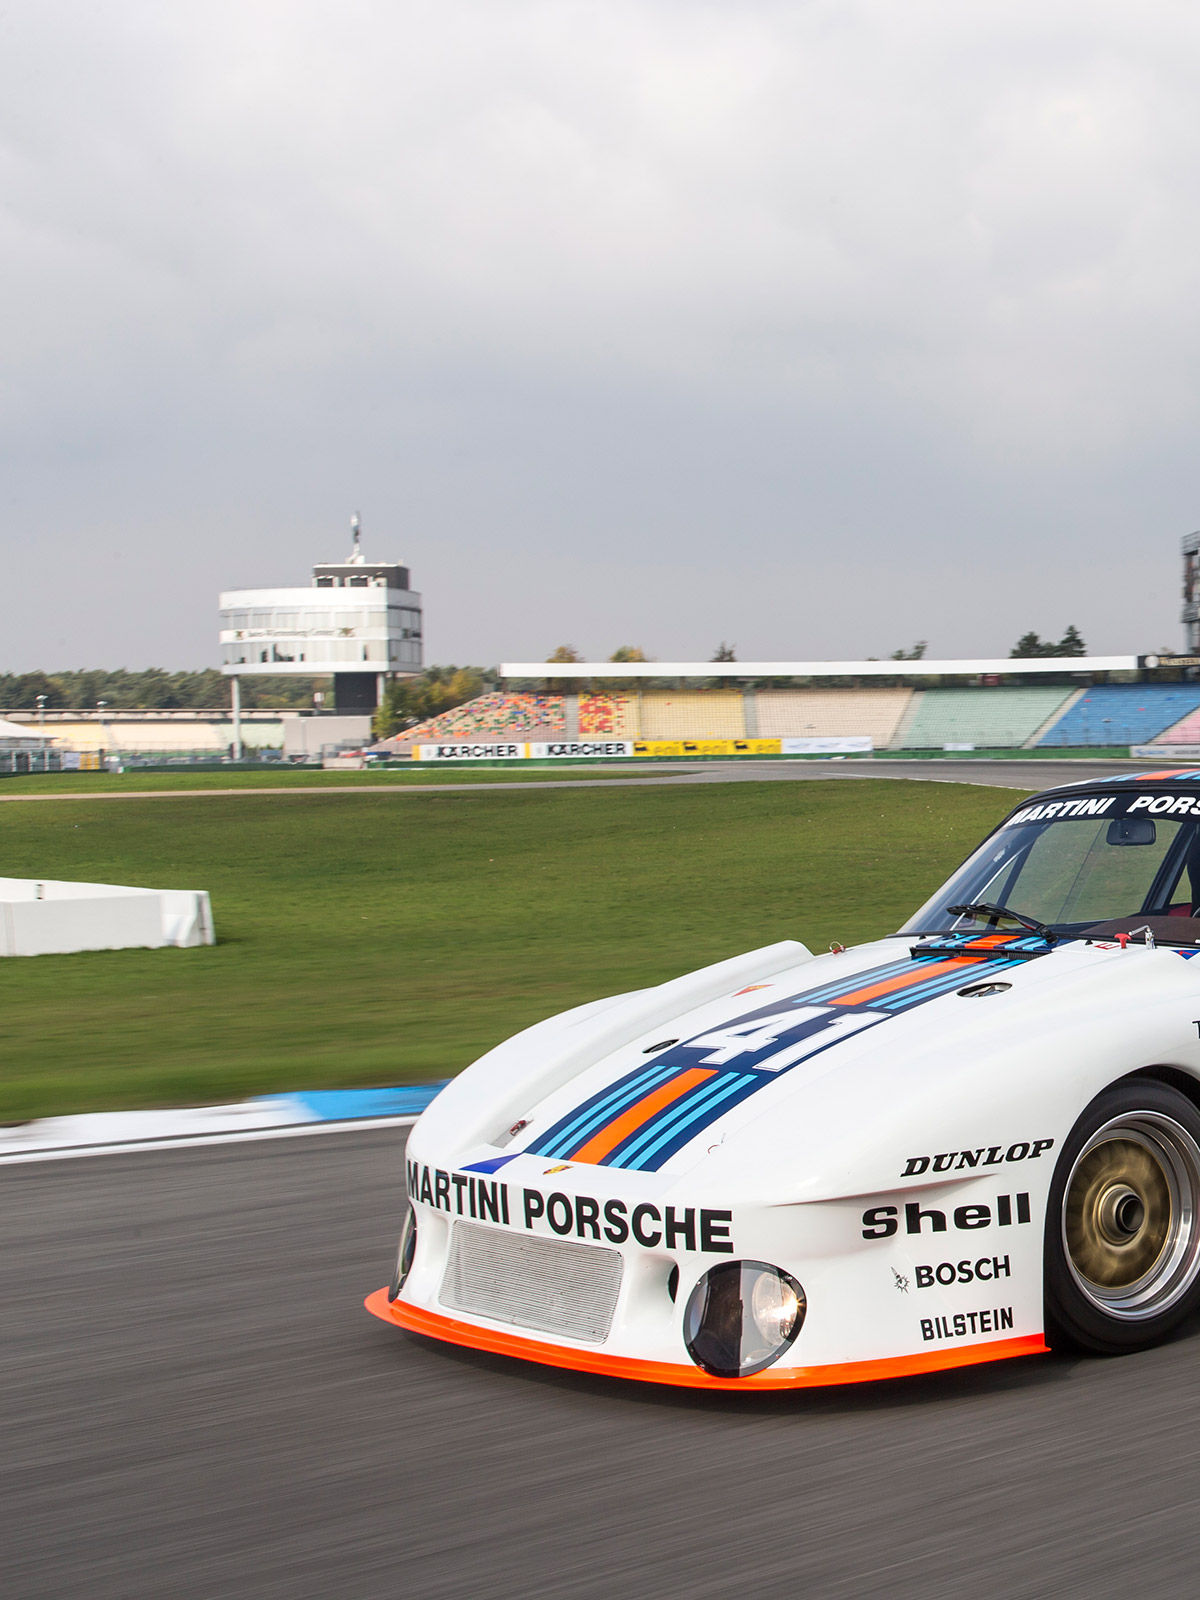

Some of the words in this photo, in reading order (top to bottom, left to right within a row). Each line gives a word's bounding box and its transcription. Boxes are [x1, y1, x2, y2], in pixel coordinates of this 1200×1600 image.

[1007, 797, 1117, 827] MARTINI
[682, 1006, 893, 1073] 41
[900, 1138, 1055, 1178] DUNLOP
[407, 1159, 511, 1225] MARTINI
[523, 1188, 734, 1254] PORSCHE
[861, 1192, 1032, 1240] Shell
[914, 1254, 1012, 1289] BOSCH
[920, 1306, 1014, 1341] BILSTEIN
